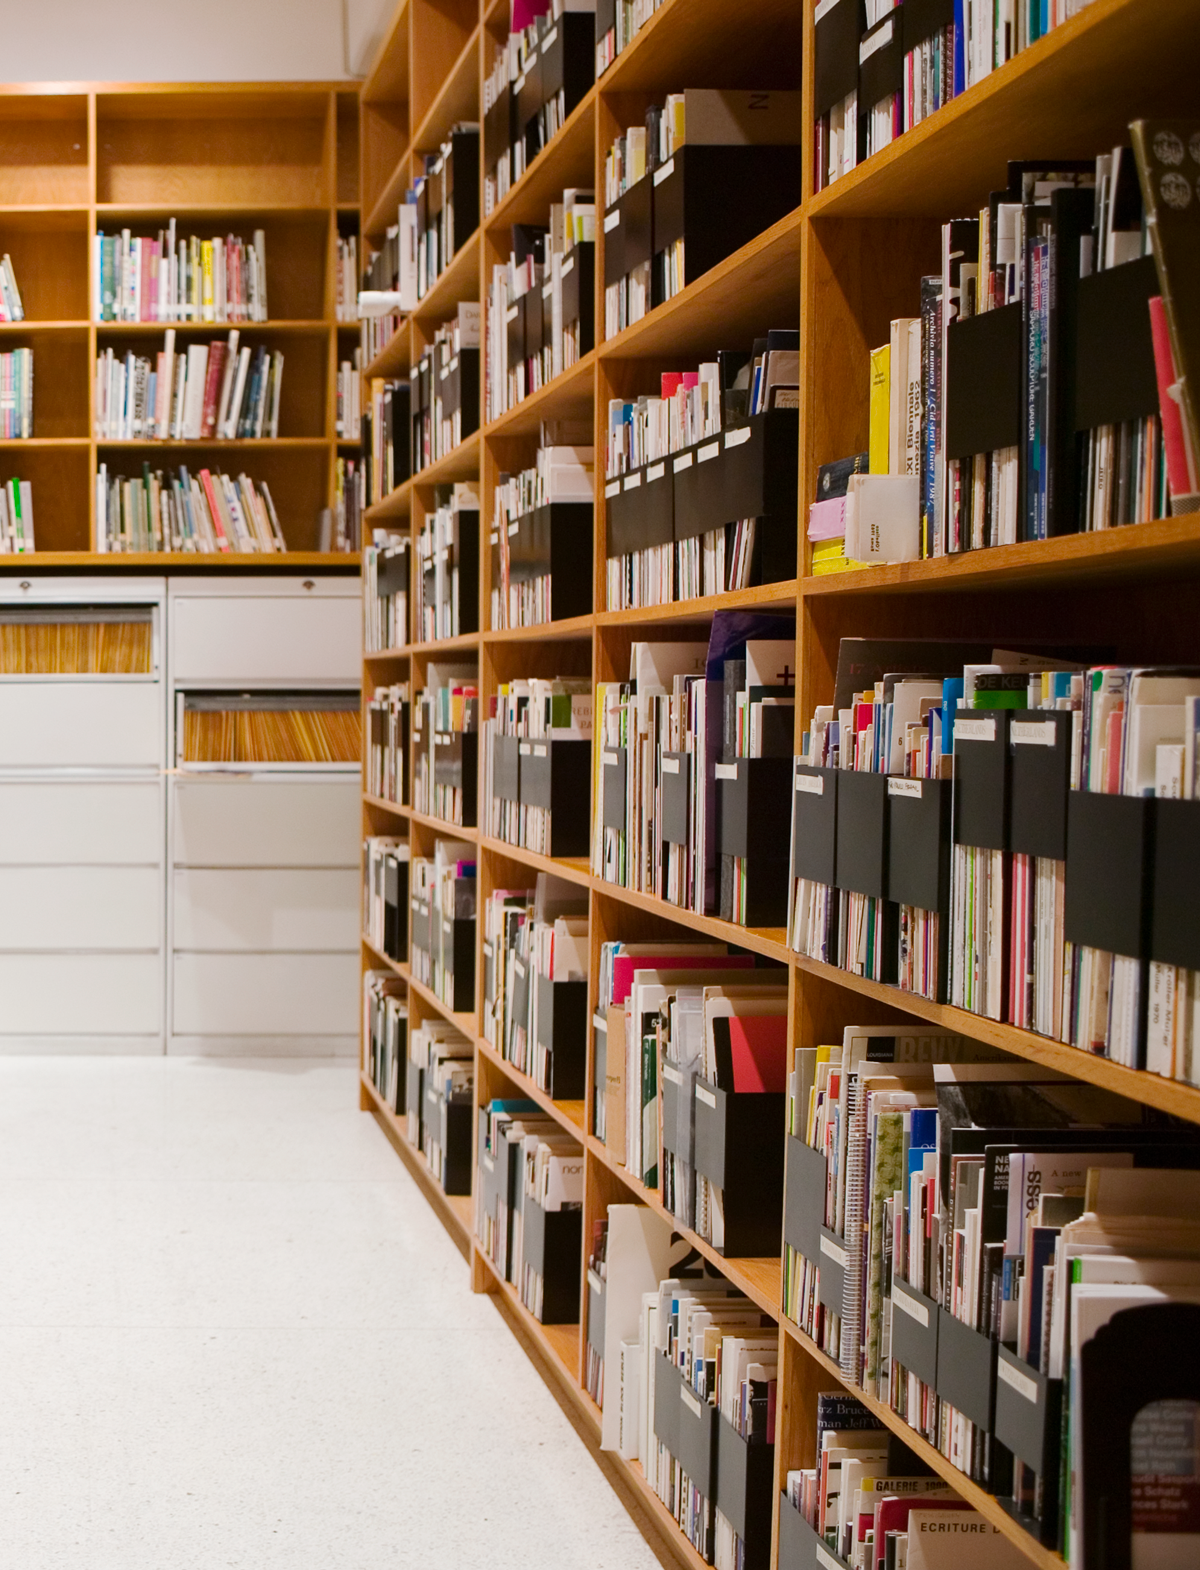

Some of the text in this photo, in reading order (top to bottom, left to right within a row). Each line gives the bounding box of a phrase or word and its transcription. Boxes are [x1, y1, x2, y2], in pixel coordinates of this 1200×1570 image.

[1028, 310, 1036, 352] SAPPORO
[906, 382, 914, 448] Biennale
[929, 404, 937, 420] Cid
[929, 424, 937, 442] Arti
[927, 481, 936, 506] 1987
[977, 677, 996, 688] DE
[1026, 1170, 1041, 1217] ess
[836, 1404, 870, 1414] Bruce
[845, 1418, 868, 1428] Jeff
[876, 1481, 918, 1492] GALERIE
[920, 1522, 986, 1532] ECRITURE
